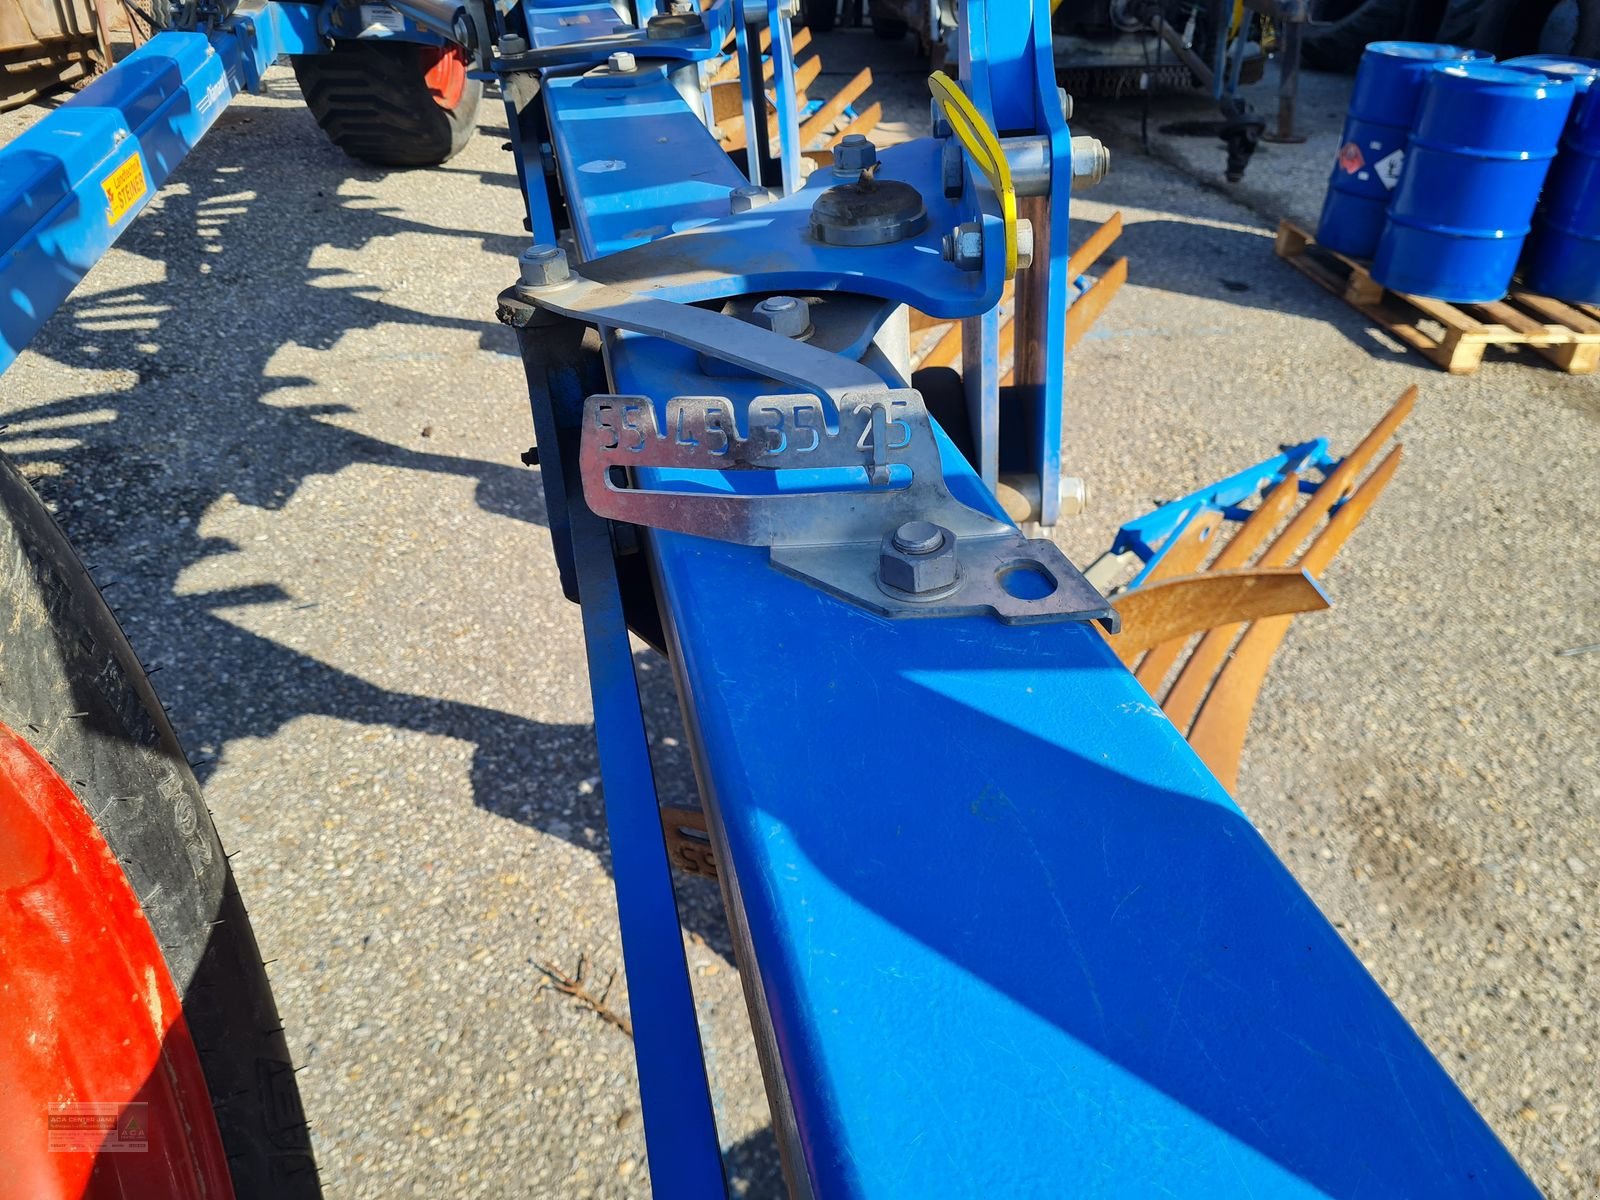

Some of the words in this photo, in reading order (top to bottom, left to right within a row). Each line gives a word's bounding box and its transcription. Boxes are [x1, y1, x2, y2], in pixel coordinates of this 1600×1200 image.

[117, 172, 145, 209] STEINER
[594, 404, 646, 452] 55
[674, 406, 729, 456] 45
[759, 404, 820, 455] 35
[852, 399, 913, 452] 25
